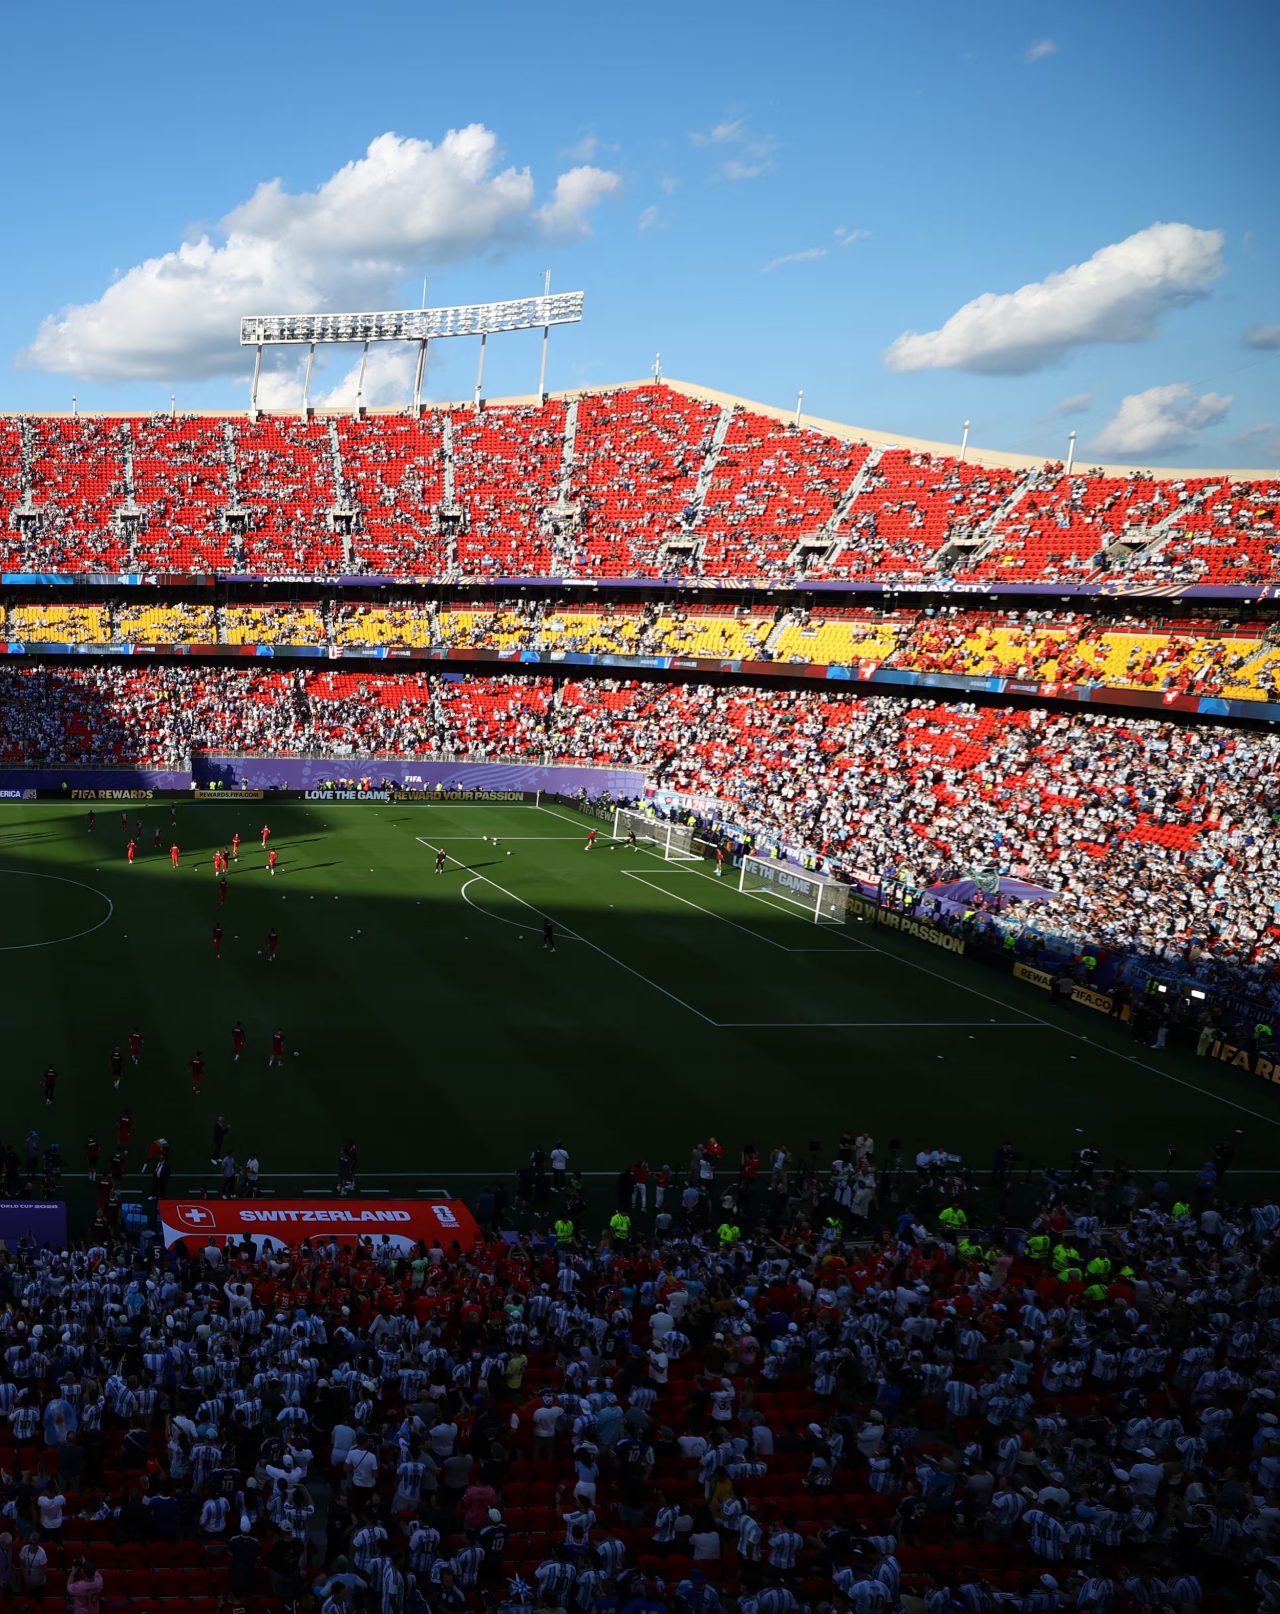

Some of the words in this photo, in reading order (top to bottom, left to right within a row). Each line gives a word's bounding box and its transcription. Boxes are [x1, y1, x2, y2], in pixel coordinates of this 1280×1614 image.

[881, 584, 951, 593] KANSAS
[952, 584, 992, 593] CITY
[405, 775, 422, 783] FIFA
[71, 789, 97, 799] FIFA
[98, 789, 153, 799] REWARDS
[199, 791, 259, 799] REWARDS.FIFA.COM
[305, 790, 334, 800] LOVE
[334, 790, 358, 800] THE
[359, 790, 390, 801] GAME
[394, 791, 442, 801] REWARD
[442, 791, 474, 801] YOUR
[475, 791, 524, 801] PASSION
[578, 803, 595, 816] FIFA
[778, 872, 811, 894] GAME
[900, 919, 966, 955] PASSION
[1211, 1039, 1250, 1072] IFA
[239, 1210, 411, 1222] SWITZERLAND
[154, 1248, 161, 1260] 5
[360, 1278, 368, 1289] 7
[628, 1450, 641, 1462] 10
[492, 1539, 505, 1550] 10
[868, 1594, 885, 1607] 10
